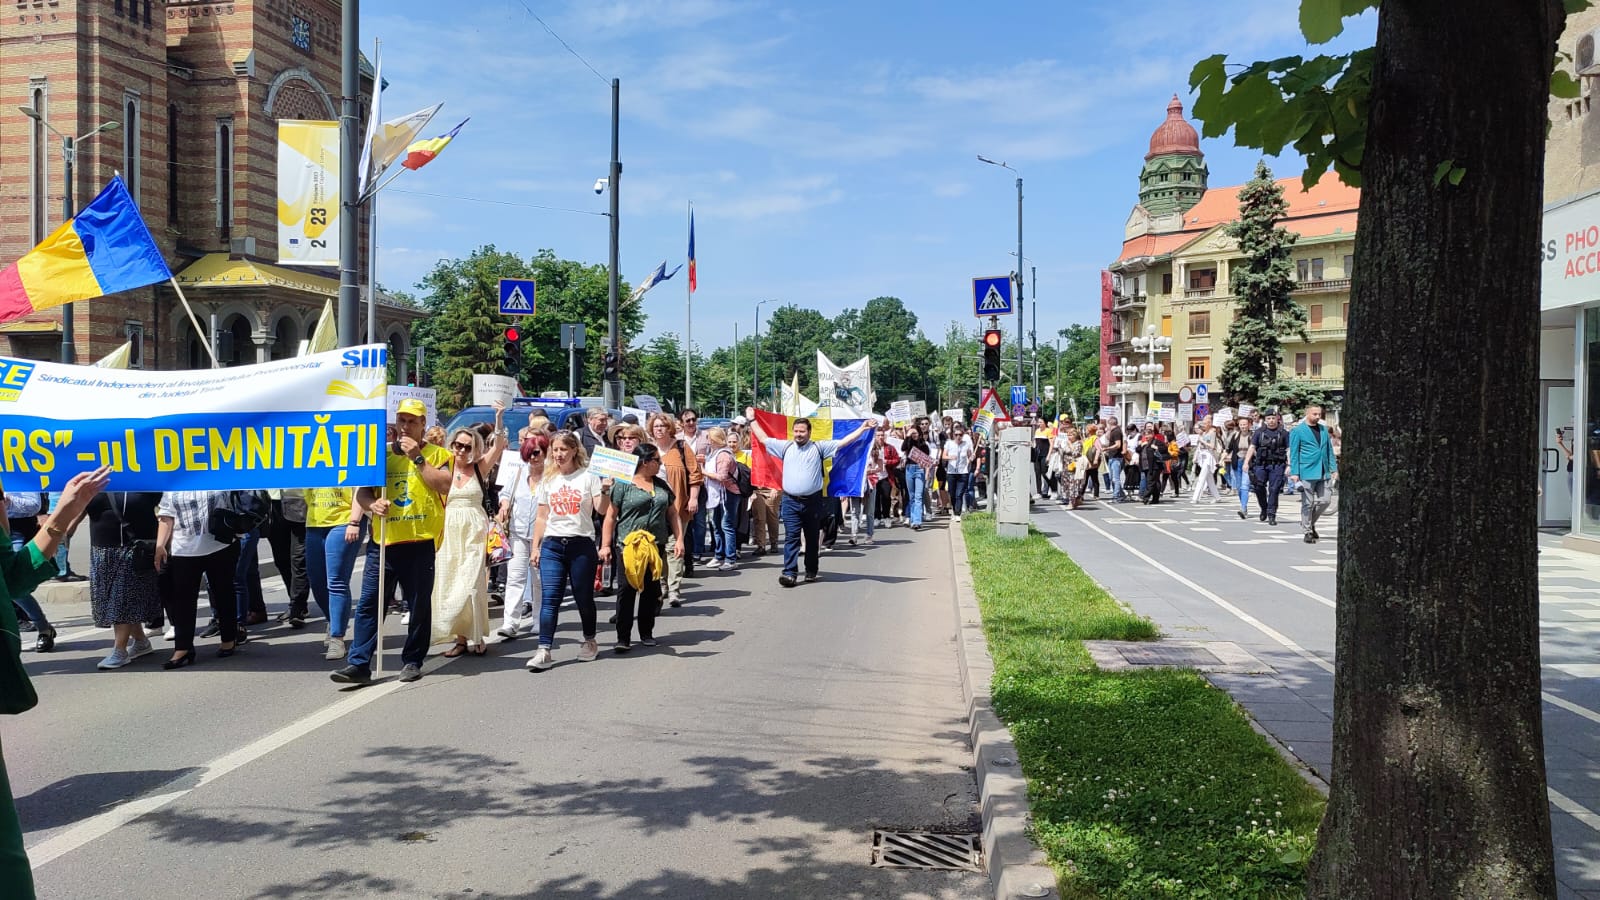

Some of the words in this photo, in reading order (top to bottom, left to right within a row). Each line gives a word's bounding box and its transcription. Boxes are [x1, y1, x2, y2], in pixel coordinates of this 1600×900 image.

[311, 208, 326, 225] 23
[38, 373, 97, 387] Sindicatul
[96, 380, 167, 390] Independent
[138, 391, 157, 399] din
[153, 414, 378, 485] DEMNITĂȚII
